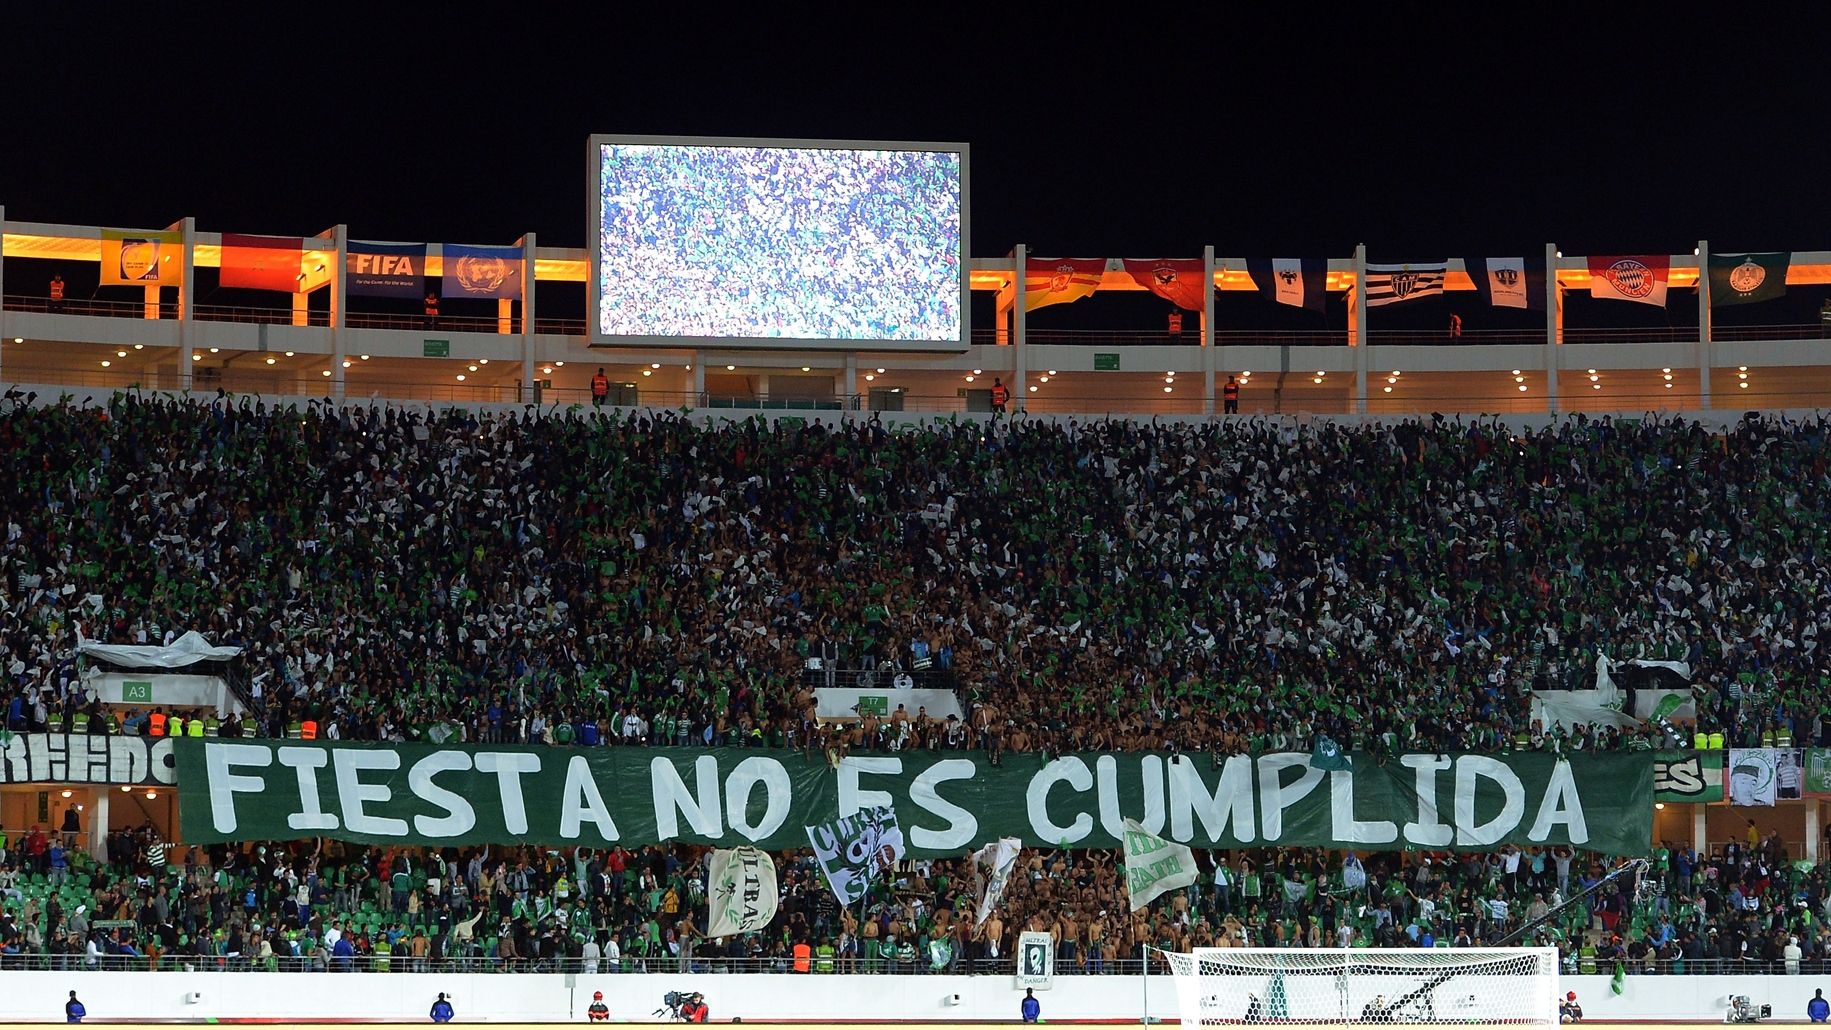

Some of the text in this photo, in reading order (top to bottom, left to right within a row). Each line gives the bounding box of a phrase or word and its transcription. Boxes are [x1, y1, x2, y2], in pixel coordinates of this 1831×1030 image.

[356, 254, 414, 276] FIFA
[129, 686, 146, 698] A3
[206, 743, 620, 841] FIESTA
[651, 755, 792, 842] NO
[1026, 753, 1588, 846] CUMPLIDA
[738, 846, 761, 931] ULTRAS
